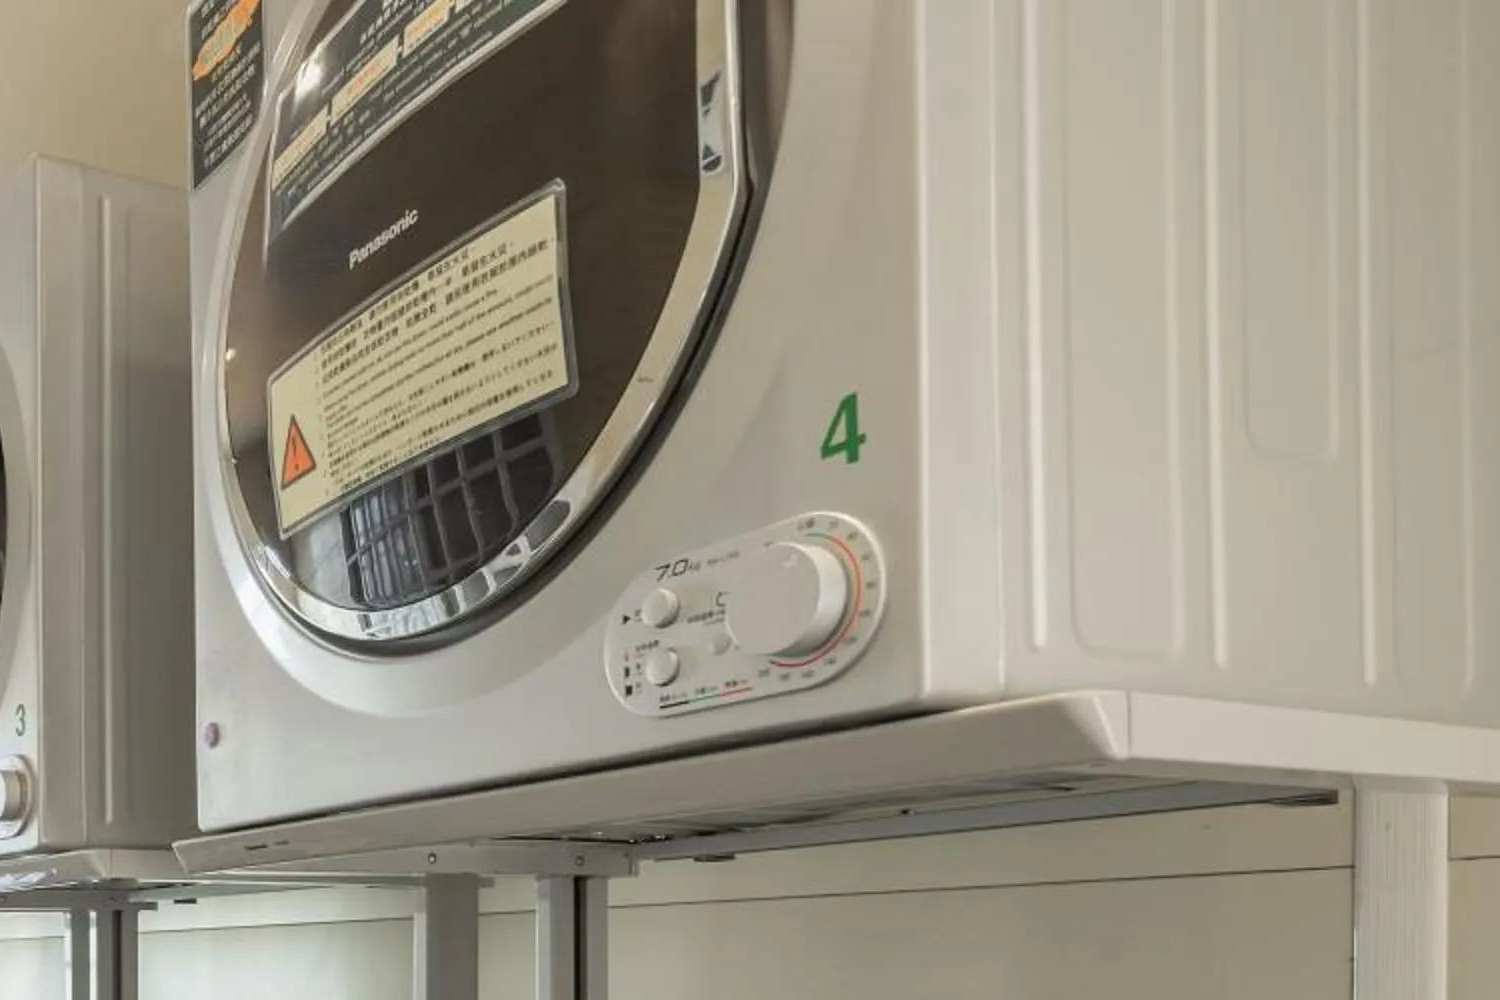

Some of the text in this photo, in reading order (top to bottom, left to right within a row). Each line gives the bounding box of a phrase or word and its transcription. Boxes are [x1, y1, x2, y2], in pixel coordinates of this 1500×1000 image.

[349, 208, 418, 271] Panasonic
[820, 392, 867, 464] 4
[15, 703, 26, 737] 3
